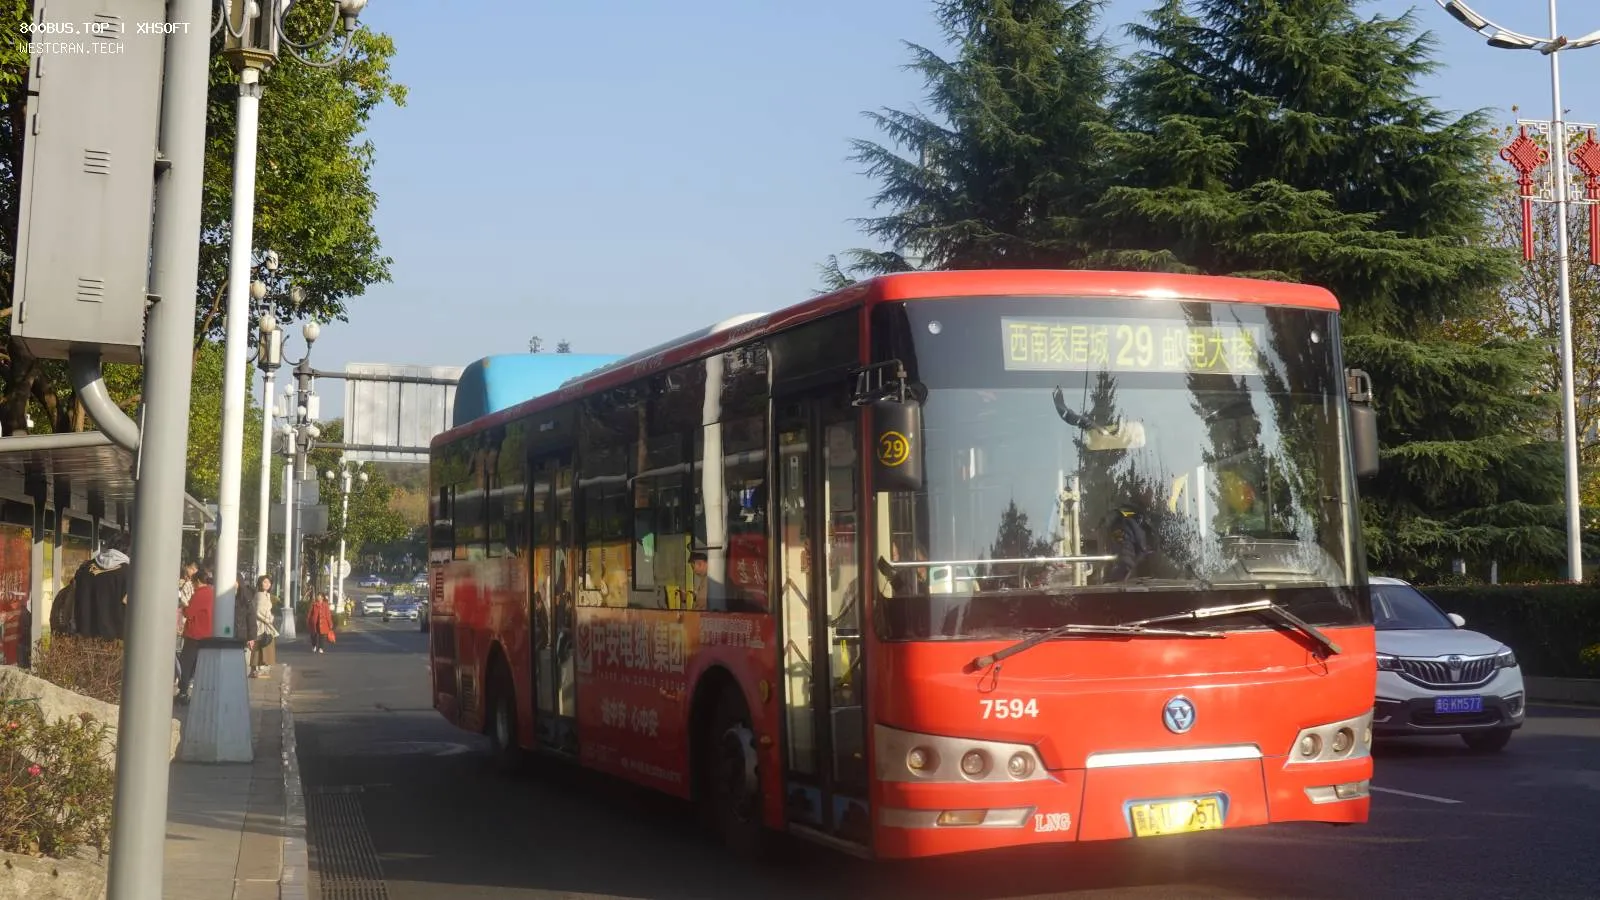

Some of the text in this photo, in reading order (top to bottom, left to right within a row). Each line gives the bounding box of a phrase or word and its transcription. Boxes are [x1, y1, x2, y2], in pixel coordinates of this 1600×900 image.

[1008, 323, 1254, 369] 西南家居城 29 邮电大楼
[883, 440, 904, 458] 29
[979, 698, 1039, 719] 7594
[1034, 812, 1071, 833] LNG
